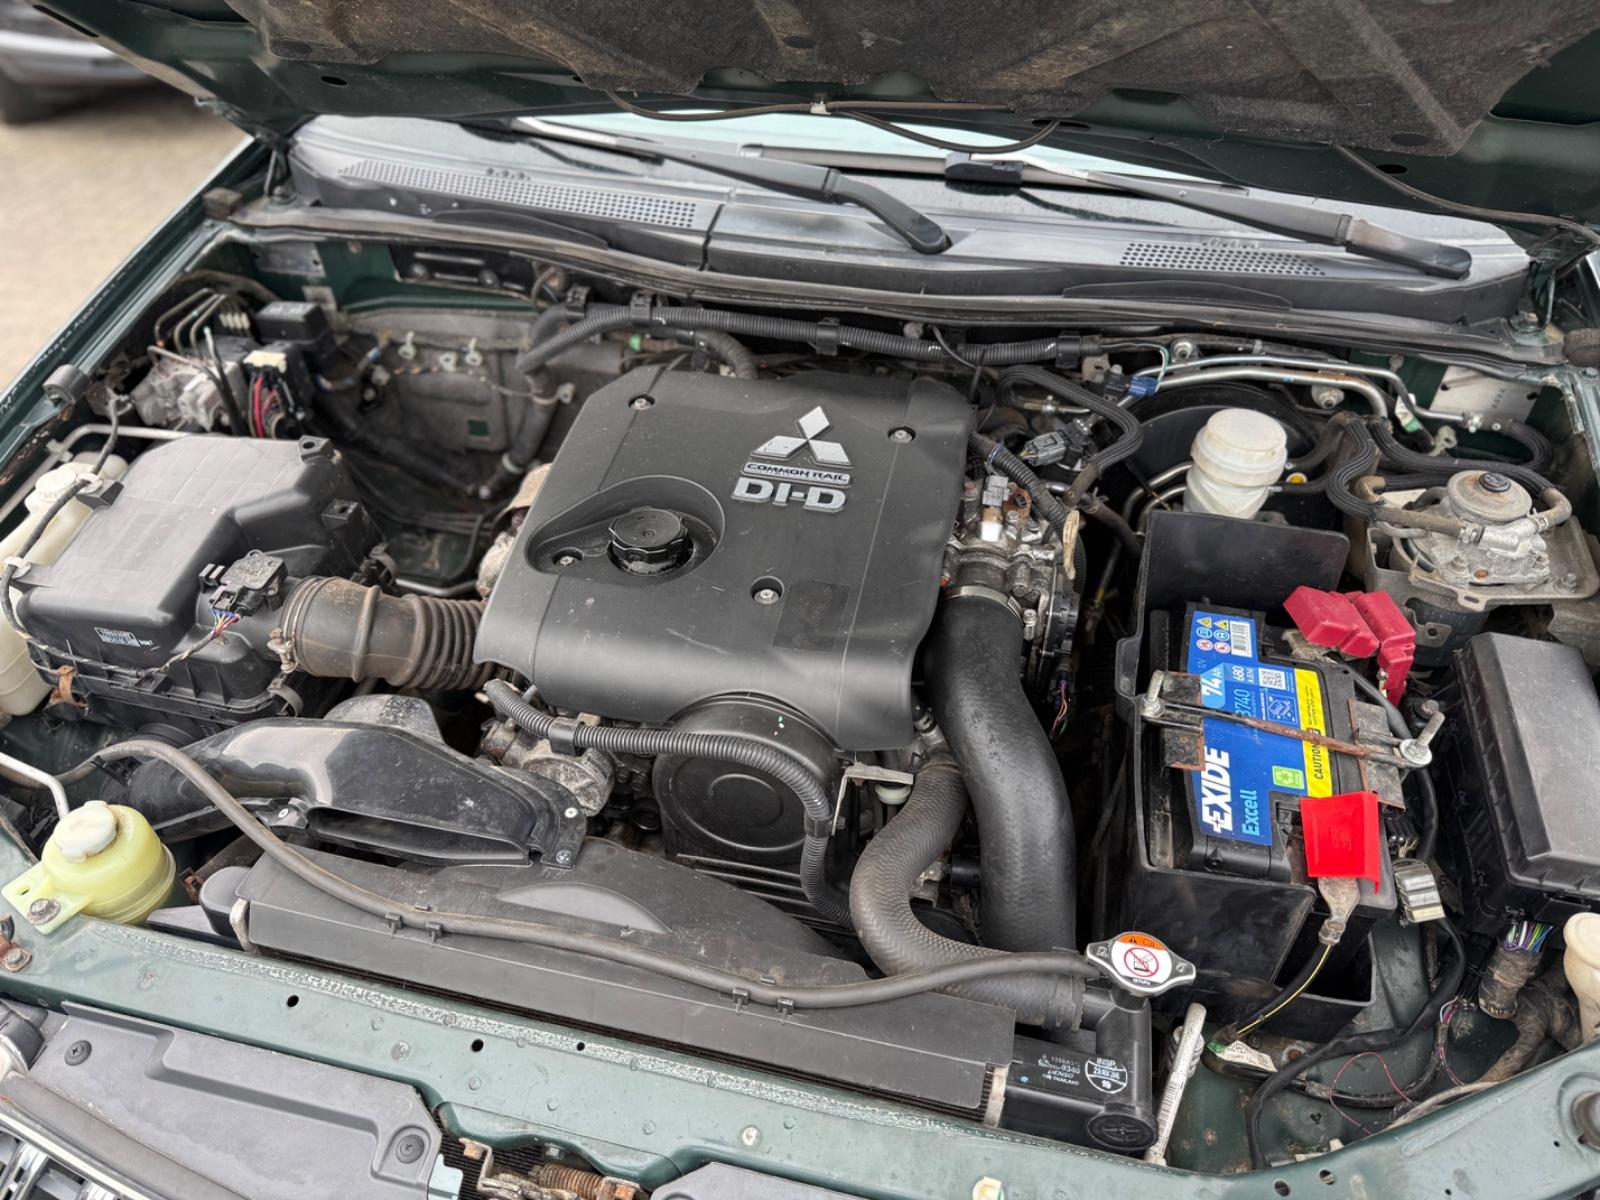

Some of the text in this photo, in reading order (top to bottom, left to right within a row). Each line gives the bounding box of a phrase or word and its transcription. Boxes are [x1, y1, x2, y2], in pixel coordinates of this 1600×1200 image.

[746, 463, 848, 482] COMMON RAIL
[731, 477, 847, 513] DI-D
[1201, 675, 1223, 697] 74
[1231, 665, 1245, 682] 680
[1201, 745, 1233, 834] EXIDE
[1240, 788, 1260, 836] Excell
